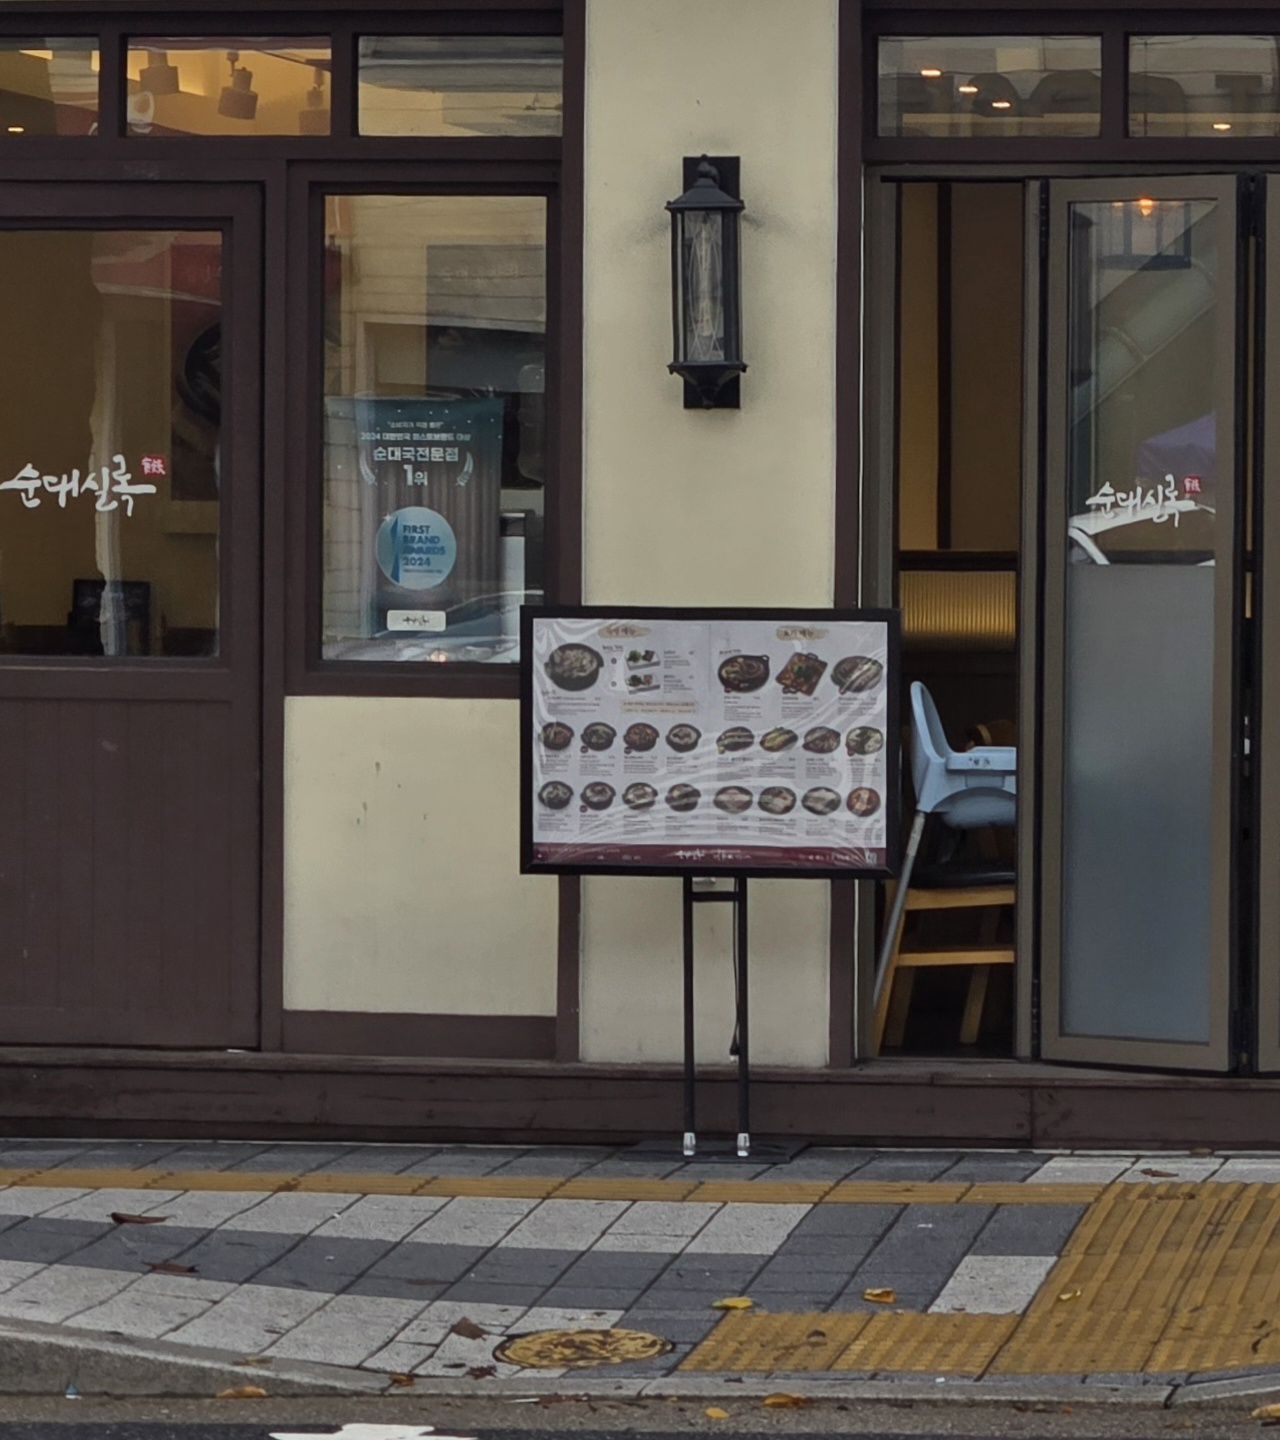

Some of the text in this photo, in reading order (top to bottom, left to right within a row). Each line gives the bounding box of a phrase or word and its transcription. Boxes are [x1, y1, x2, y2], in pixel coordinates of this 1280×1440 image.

[373, 446, 459, 462] 순대국전문점
[403, 464, 429, 486] 1위
[1085, 474, 1196, 528] 순대실록
[402, 525, 431, 534] FIRST
[402, 536, 440, 545] BRAND
[402, 546, 446, 555] AWARDS
[402, 557, 431, 566] 2024
